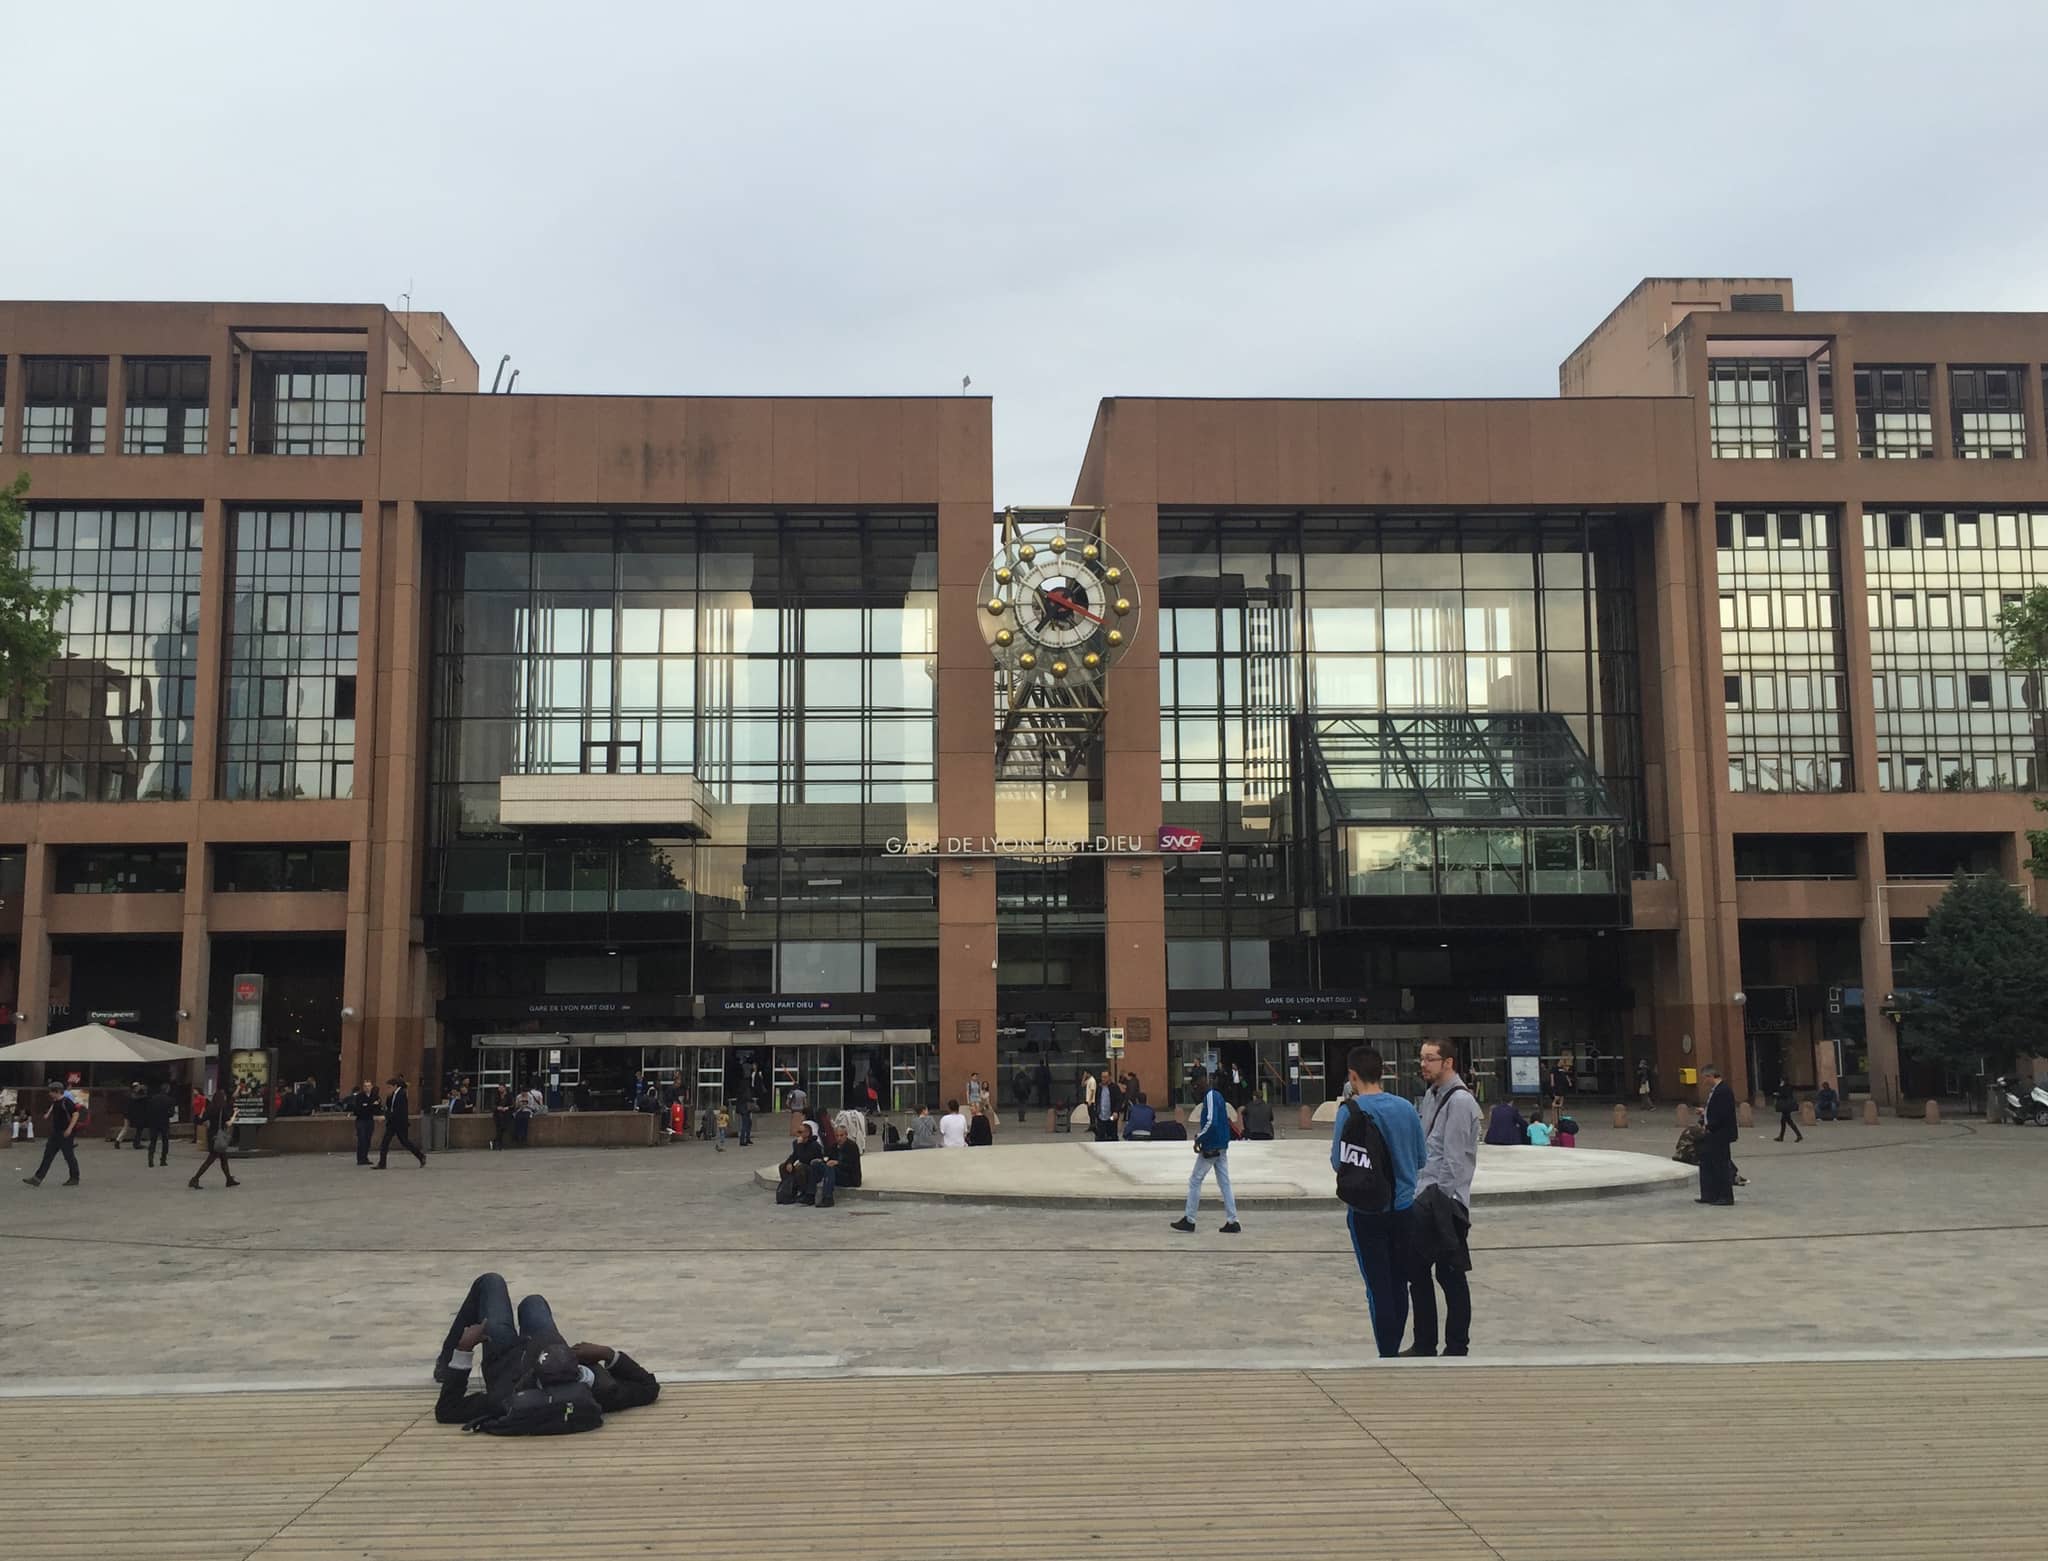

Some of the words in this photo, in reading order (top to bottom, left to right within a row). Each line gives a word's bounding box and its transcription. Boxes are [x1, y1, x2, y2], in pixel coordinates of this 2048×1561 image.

[885, 836, 939, 853] GARE
[947, 836, 973, 853] DE
[982, 836, 1034, 853] LYON
[1044, 835, 1142, 852] PART-DIEU
[1160, 834, 1201, 849] SNCF
[560, 1004, 579, 1012] LYON
[796, 1001, 814, 1009] DIEU
[1340, 1140, 1373, 1170] VAN
